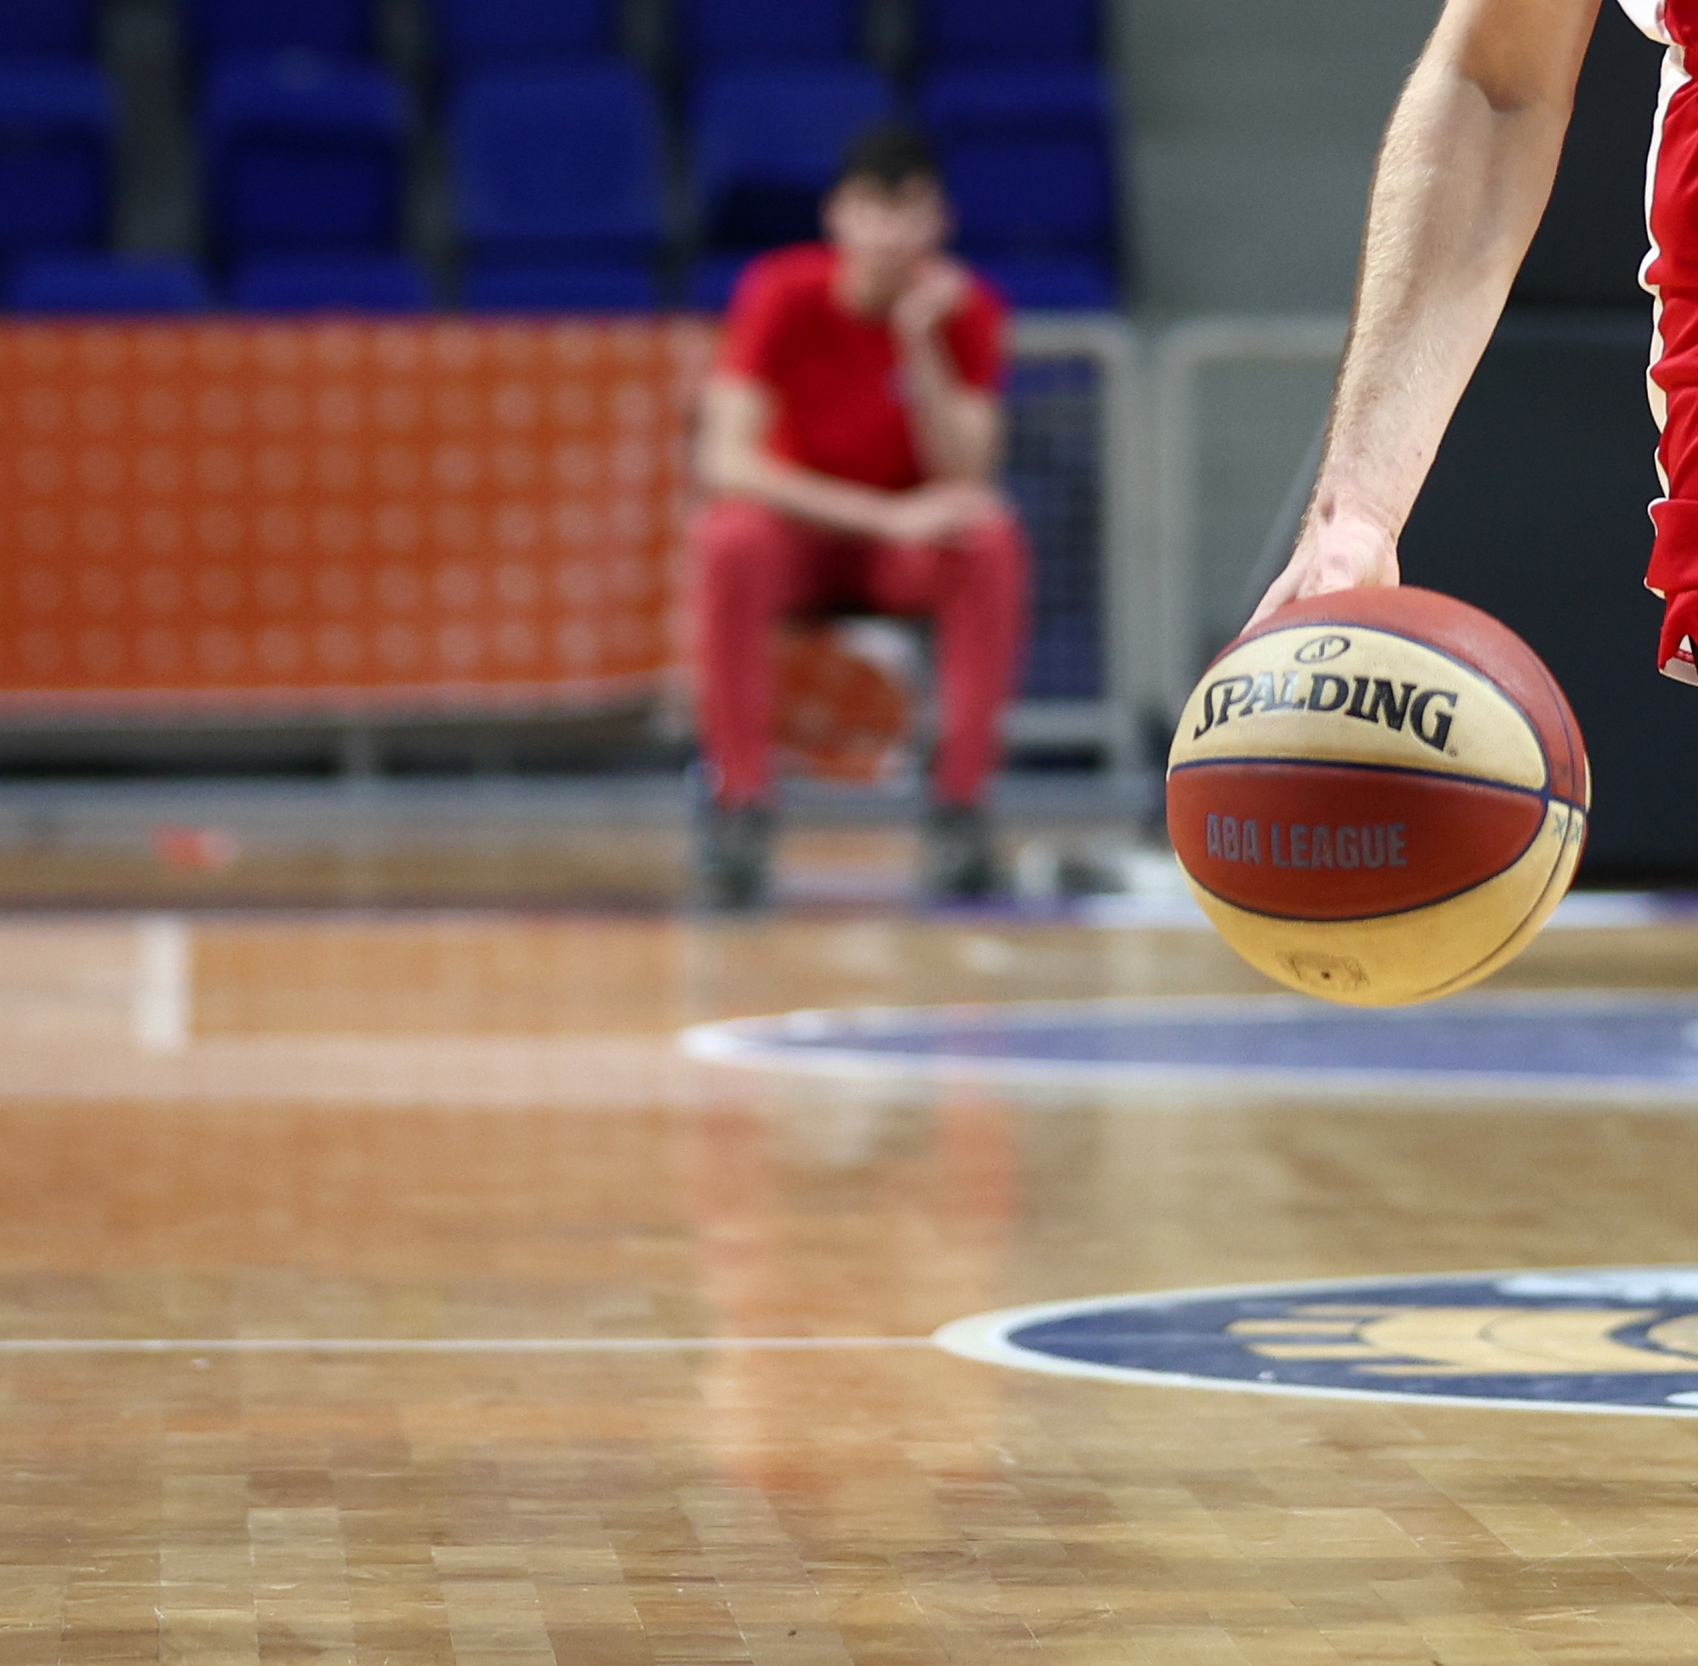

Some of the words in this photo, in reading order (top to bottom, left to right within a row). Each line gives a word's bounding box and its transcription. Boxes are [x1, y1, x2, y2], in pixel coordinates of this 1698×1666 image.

[1193, 671, 1458, 752] SPALDING
[1206, 811, 1262, 865] ABA
[1271, 822, 1408, 870] LEAGUE
